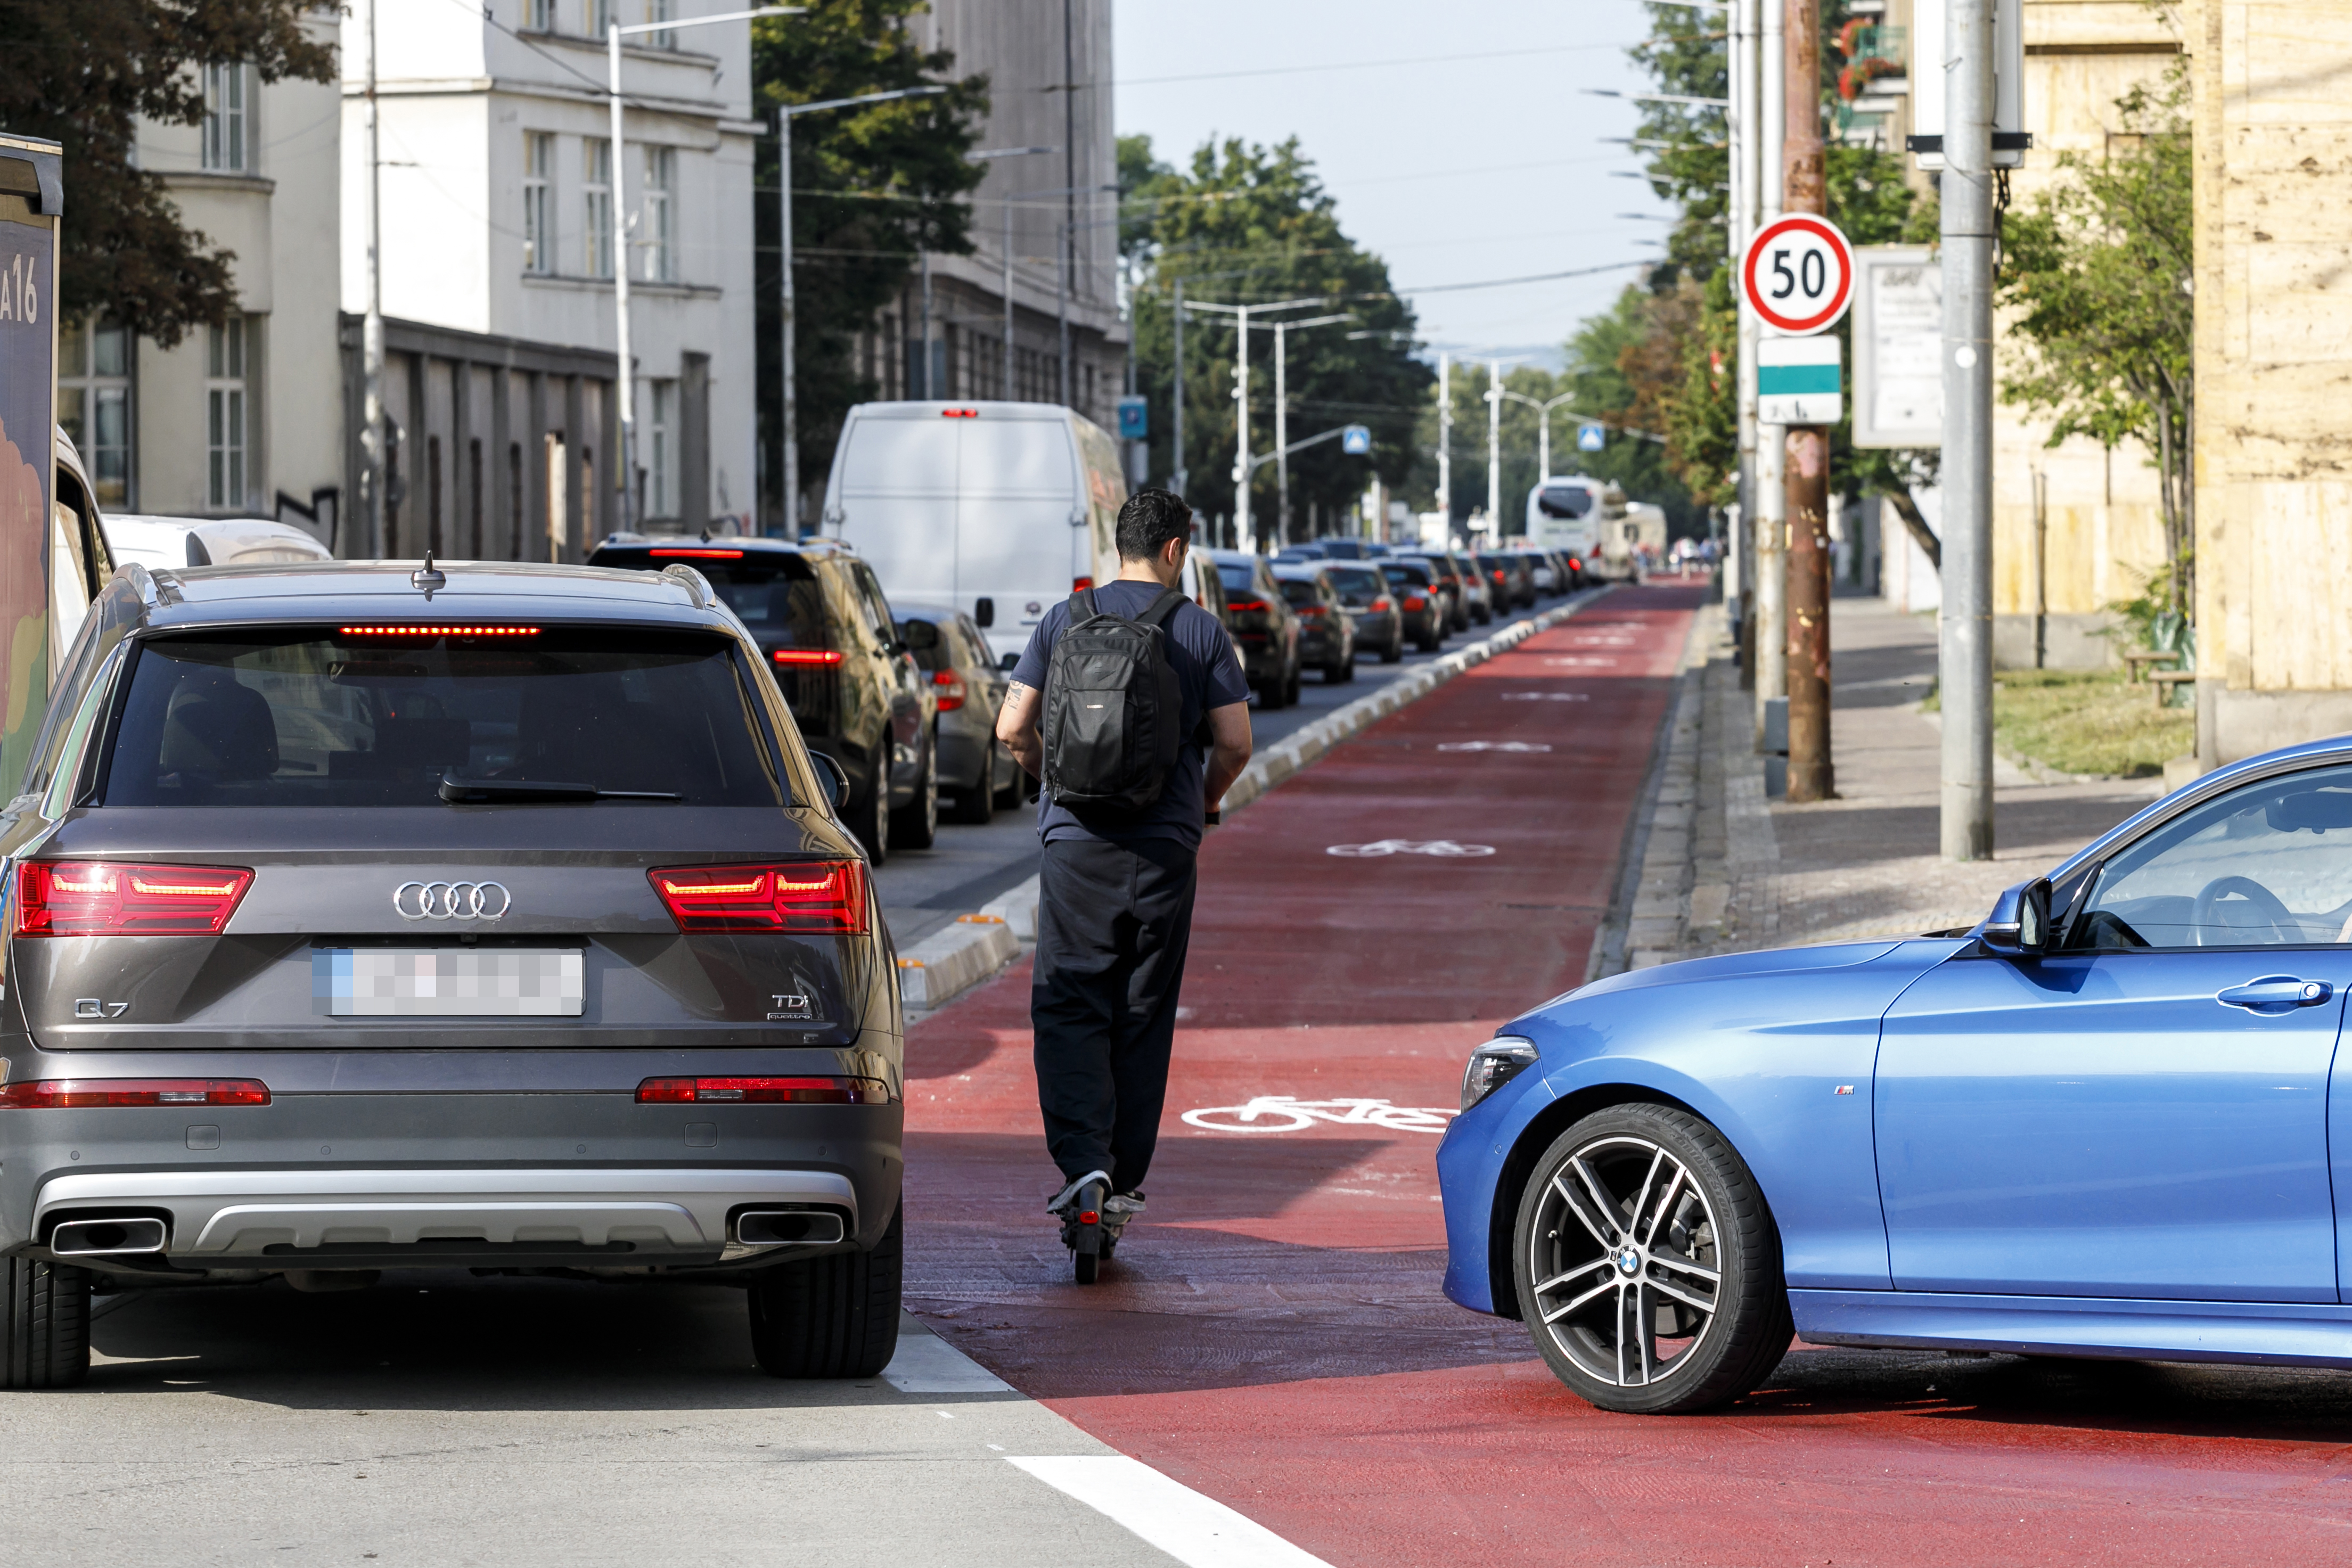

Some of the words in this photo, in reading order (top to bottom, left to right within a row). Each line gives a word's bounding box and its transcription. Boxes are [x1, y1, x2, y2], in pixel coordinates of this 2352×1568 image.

[1772, 249, 1825, 299] 50
[75, 998, 128, 1018] Q7
[772, 995, 808, 1008] TDI
[1617, 1245, 1635, 1264] BMW
